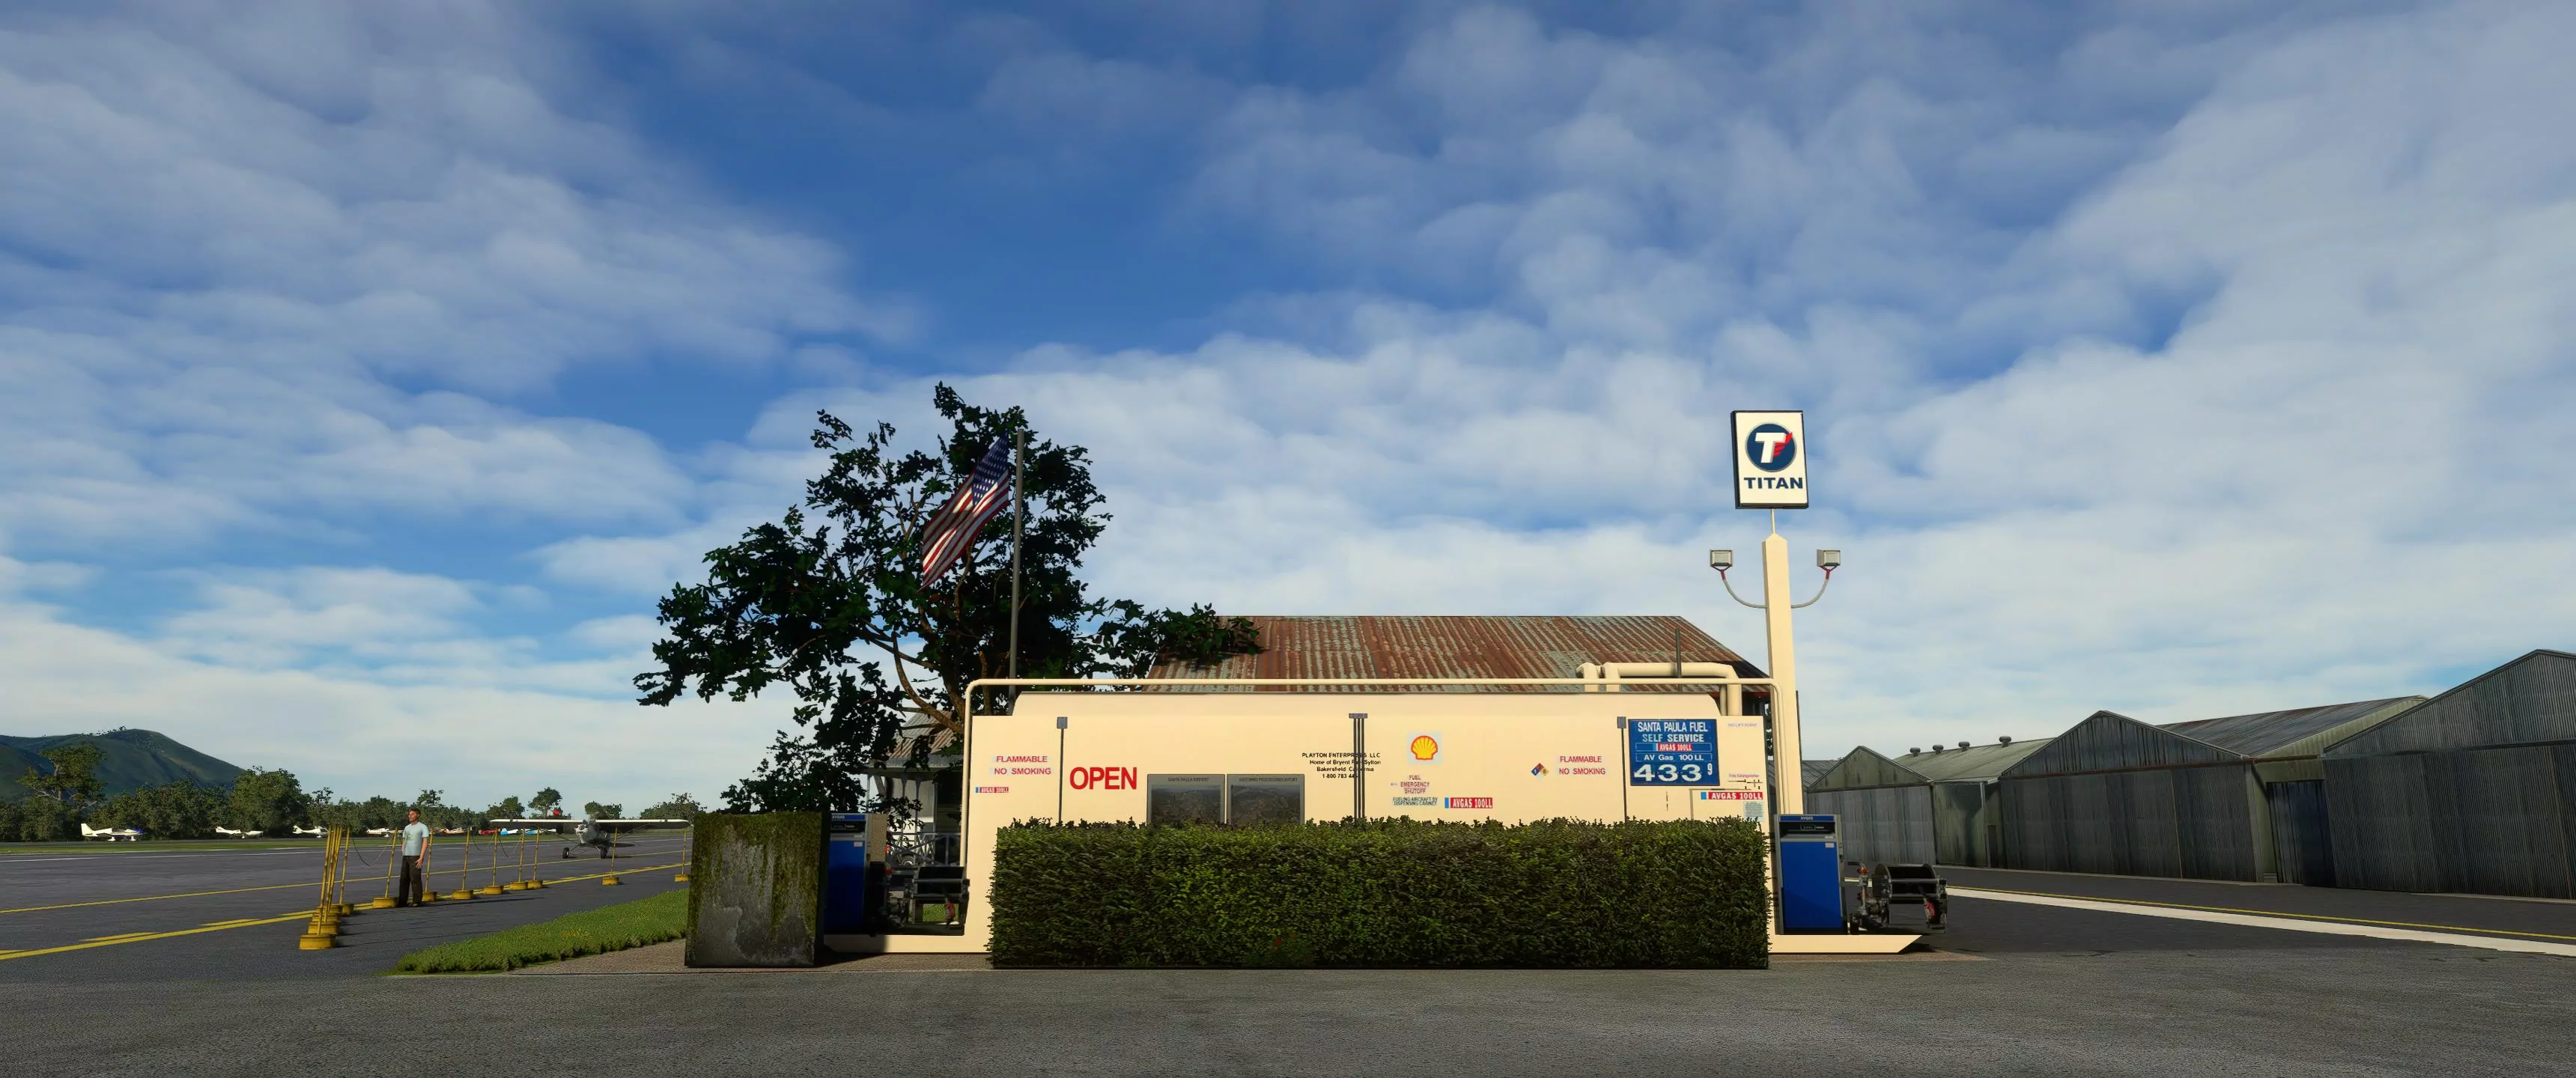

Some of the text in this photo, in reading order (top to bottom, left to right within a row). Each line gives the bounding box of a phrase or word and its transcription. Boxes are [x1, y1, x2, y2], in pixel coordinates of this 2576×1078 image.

[1743, 477, 1803, 489] TITAN
[1638, 722, 1708, 733] SANTA PAULA FUEL
[1642, 734, 1704, 743] SELF SERVICE
[1069, 767, 1137, 790] OPEN
[1453, 799, 1492, 808] AVGAS 100LL
